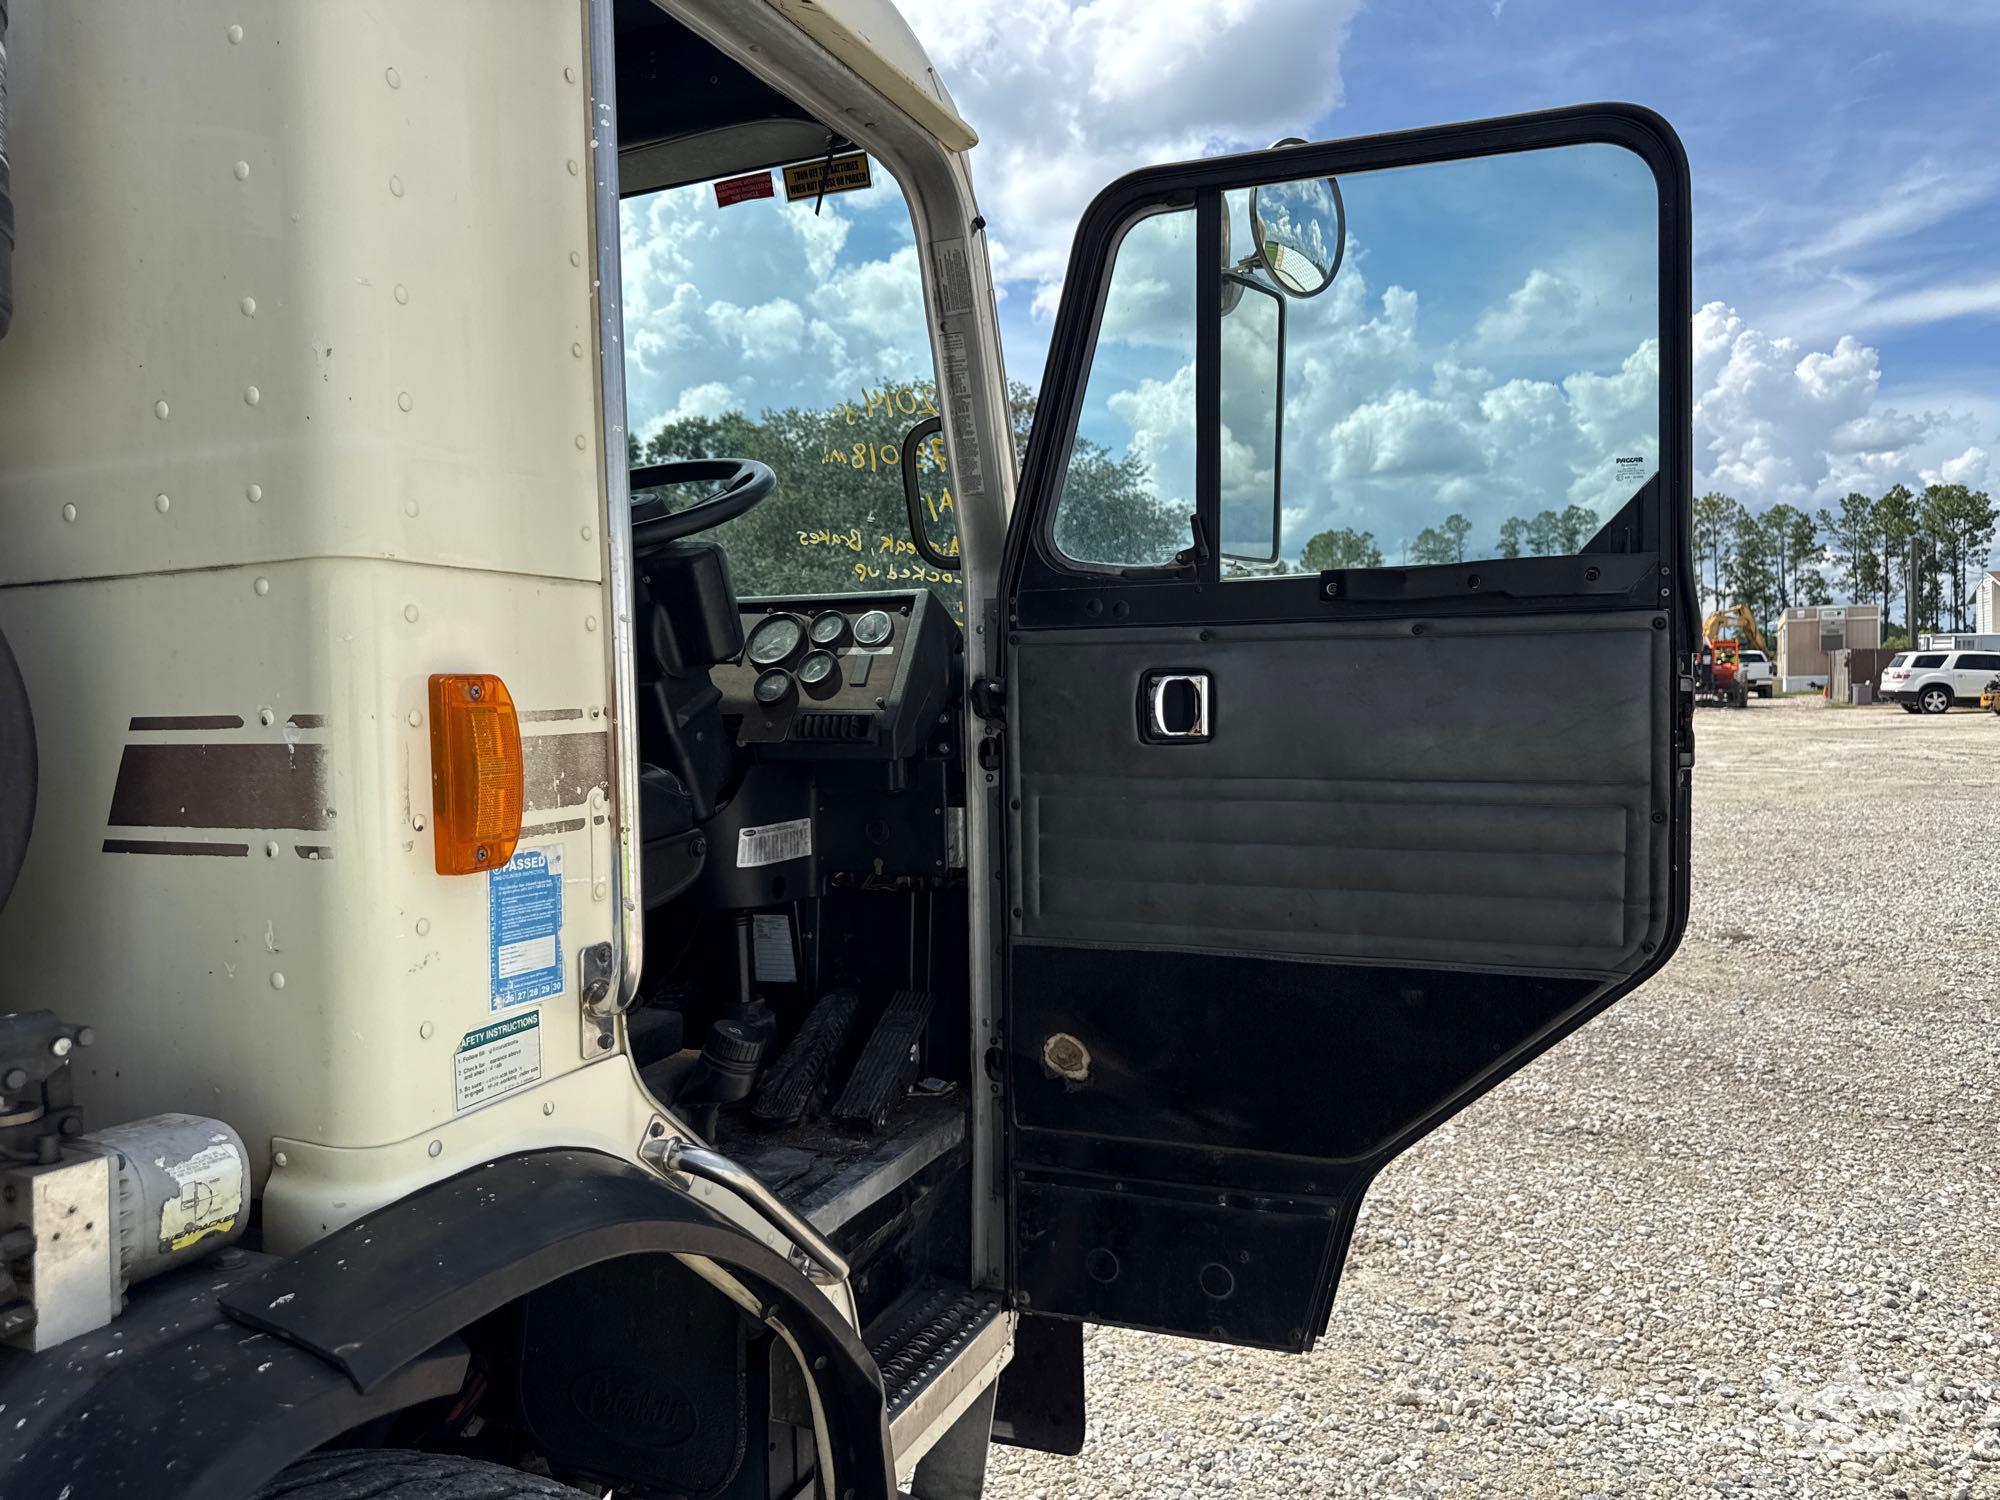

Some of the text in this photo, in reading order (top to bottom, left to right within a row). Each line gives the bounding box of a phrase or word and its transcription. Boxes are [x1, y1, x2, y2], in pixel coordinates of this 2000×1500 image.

[845, 172, 867, 184] PARKED
[502, 856, 546, 873] PASSED
[517, 991, 527, 1001] 27
[529, 988, 539, 997] 28
[541, 985, 550, 994] 29
[552, 981, 561, 991] 30
[460, 1014, 538, 1048] AFETY INSTRUCTIONS
